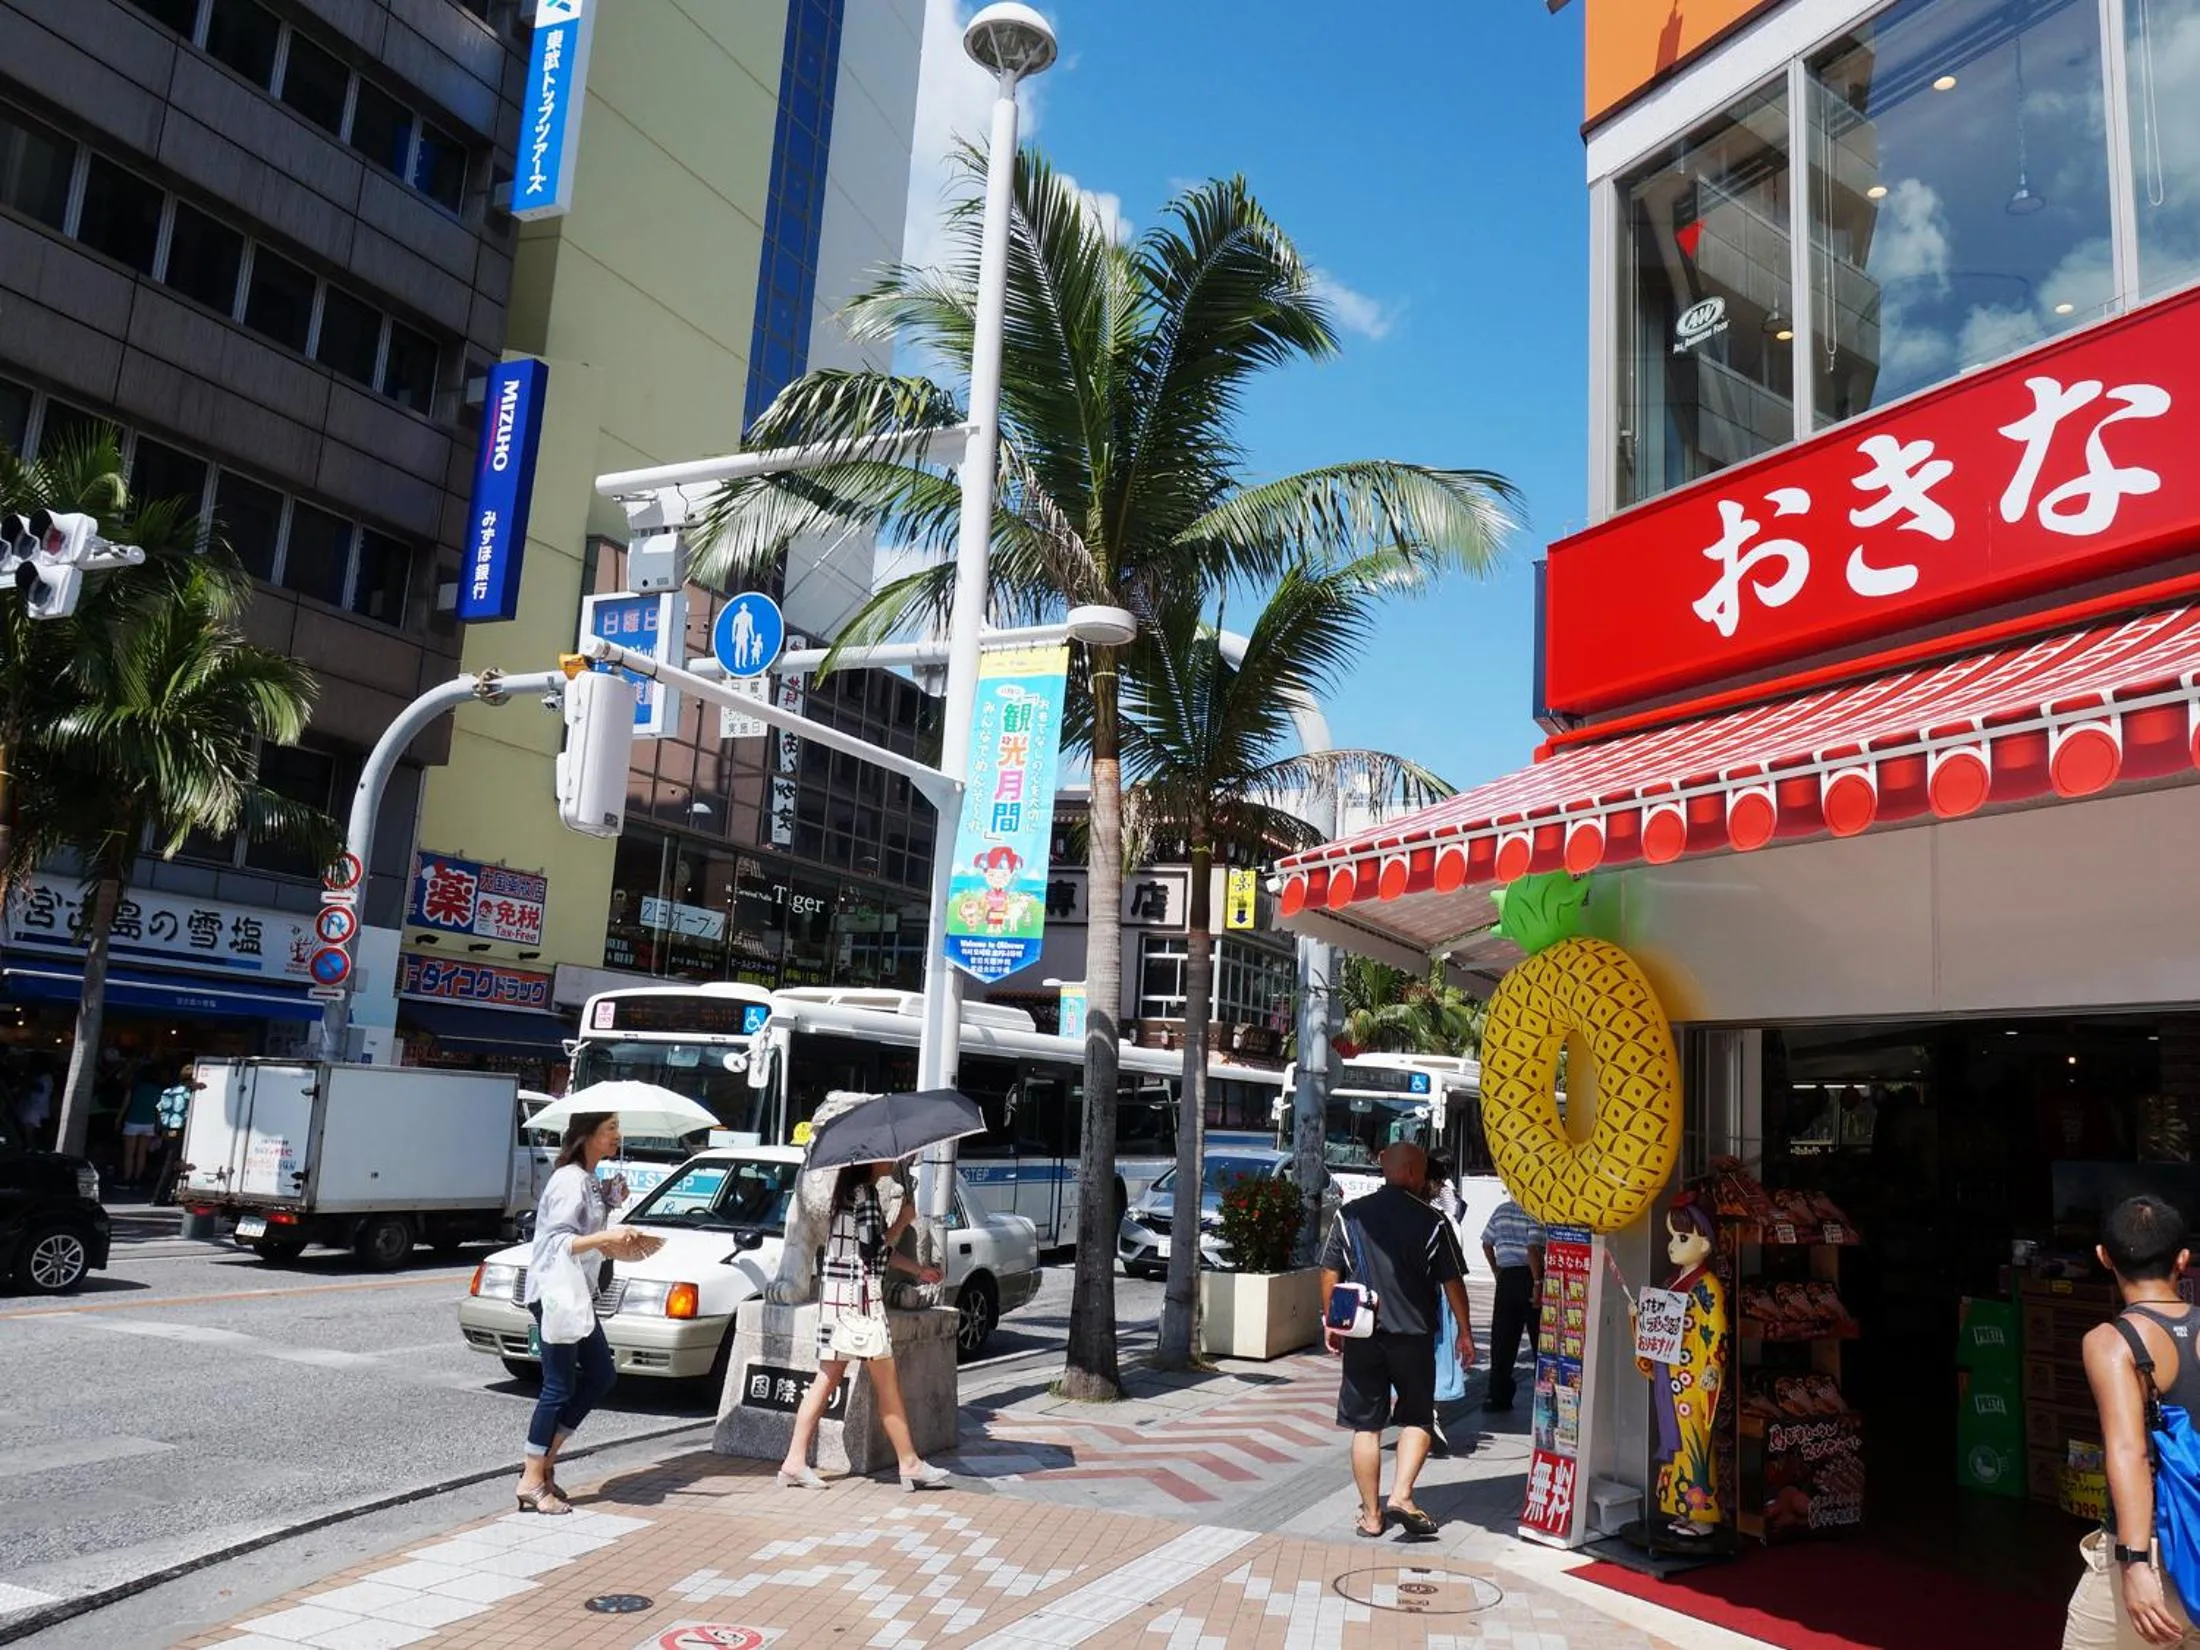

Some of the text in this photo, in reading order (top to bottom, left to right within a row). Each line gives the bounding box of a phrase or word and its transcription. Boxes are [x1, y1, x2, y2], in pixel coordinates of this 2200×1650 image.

[525, 28, 564, 195] 東武トップツアーズ
[492, 379, 520, 472] MIZUHO
[1692, 376, 2172, 637] おきな
[472, 510, 497, 600] みずほ銀行
[603, 607, 658, 635] 日曜日
[424, 859, 477, 928] 薬
[494, 900, 540, 931] 免税
[772, 884, 825, 914] Tiger
[495, 925, 537, 943] Tax-Free
[421, 960, 547, 1004] ダイコクドラッグ
[603, 1168, 694, 1191] NN-SP
[750, 1374, 842, 1409] 国際り
[1523, 1453, 1575, 1532] 無料
